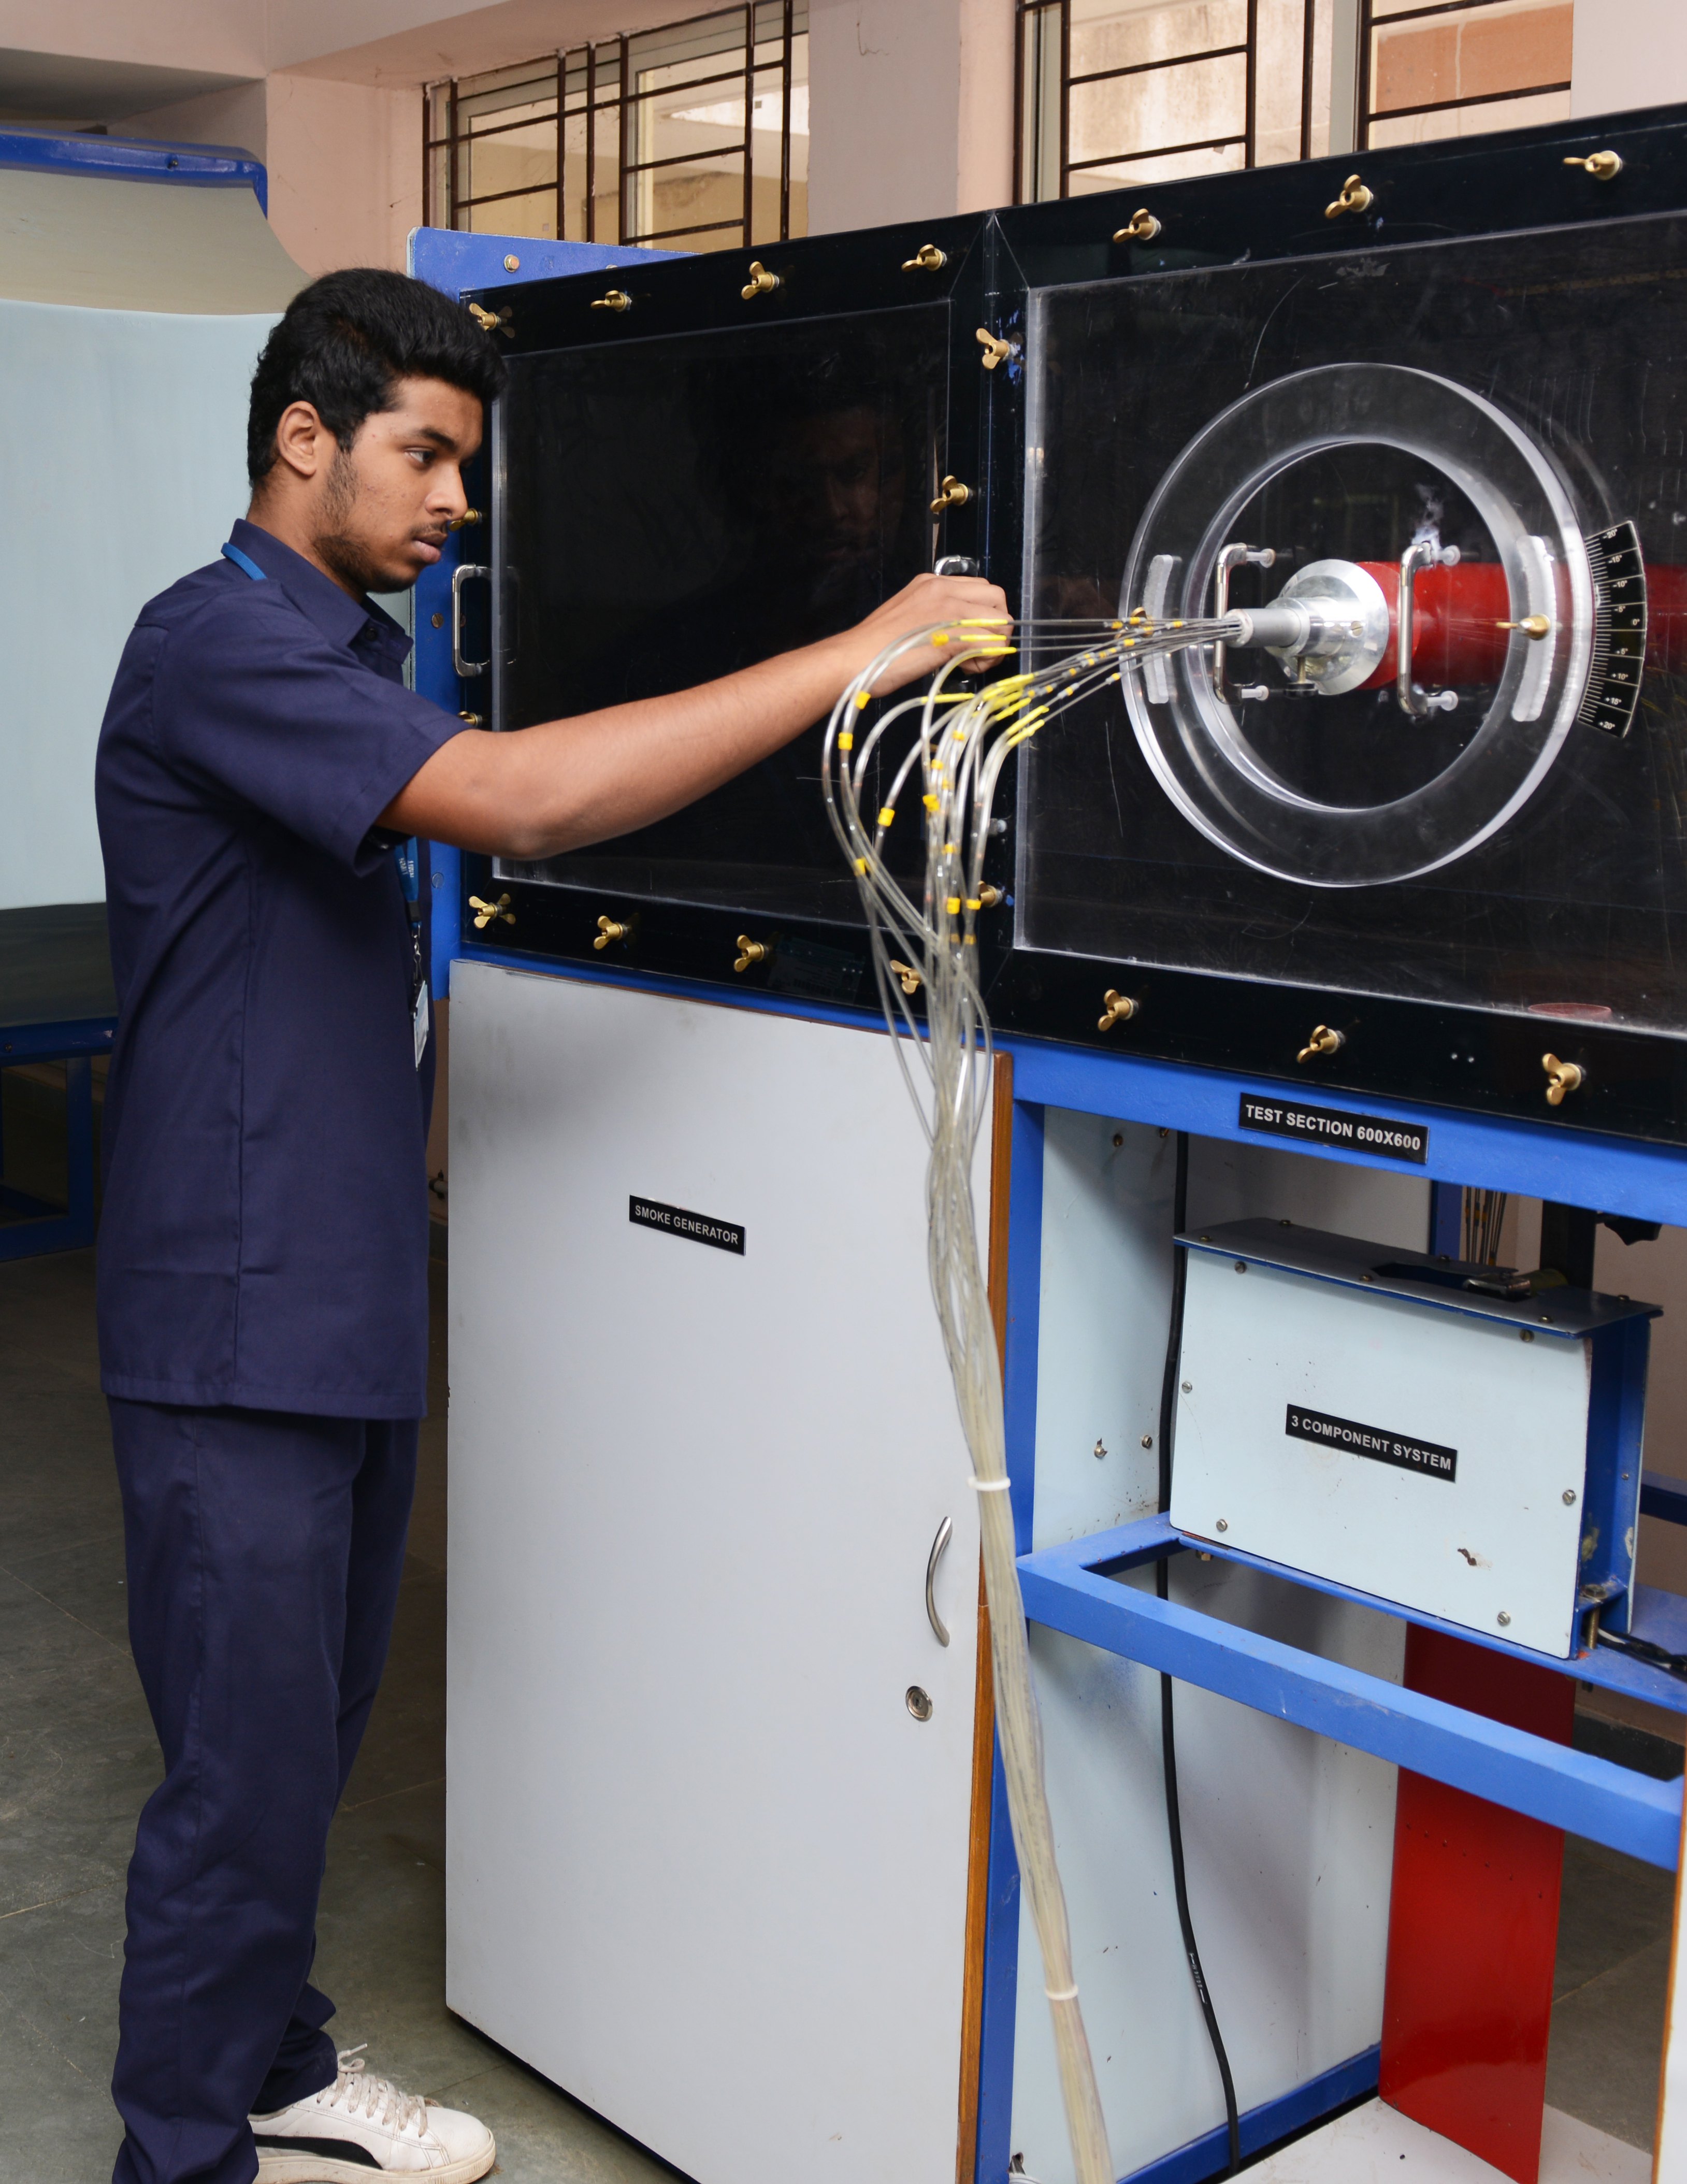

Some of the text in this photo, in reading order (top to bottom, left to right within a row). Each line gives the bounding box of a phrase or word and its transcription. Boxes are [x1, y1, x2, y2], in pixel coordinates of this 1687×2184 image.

[1246, 1104, 1420, 1150] TEST SECTION 600X600
[635, 1205, 738, 1244] SMOKE GENERATOR
[1291, 1415, 1451, 1471] 3 COMPONENT SYSTEM
